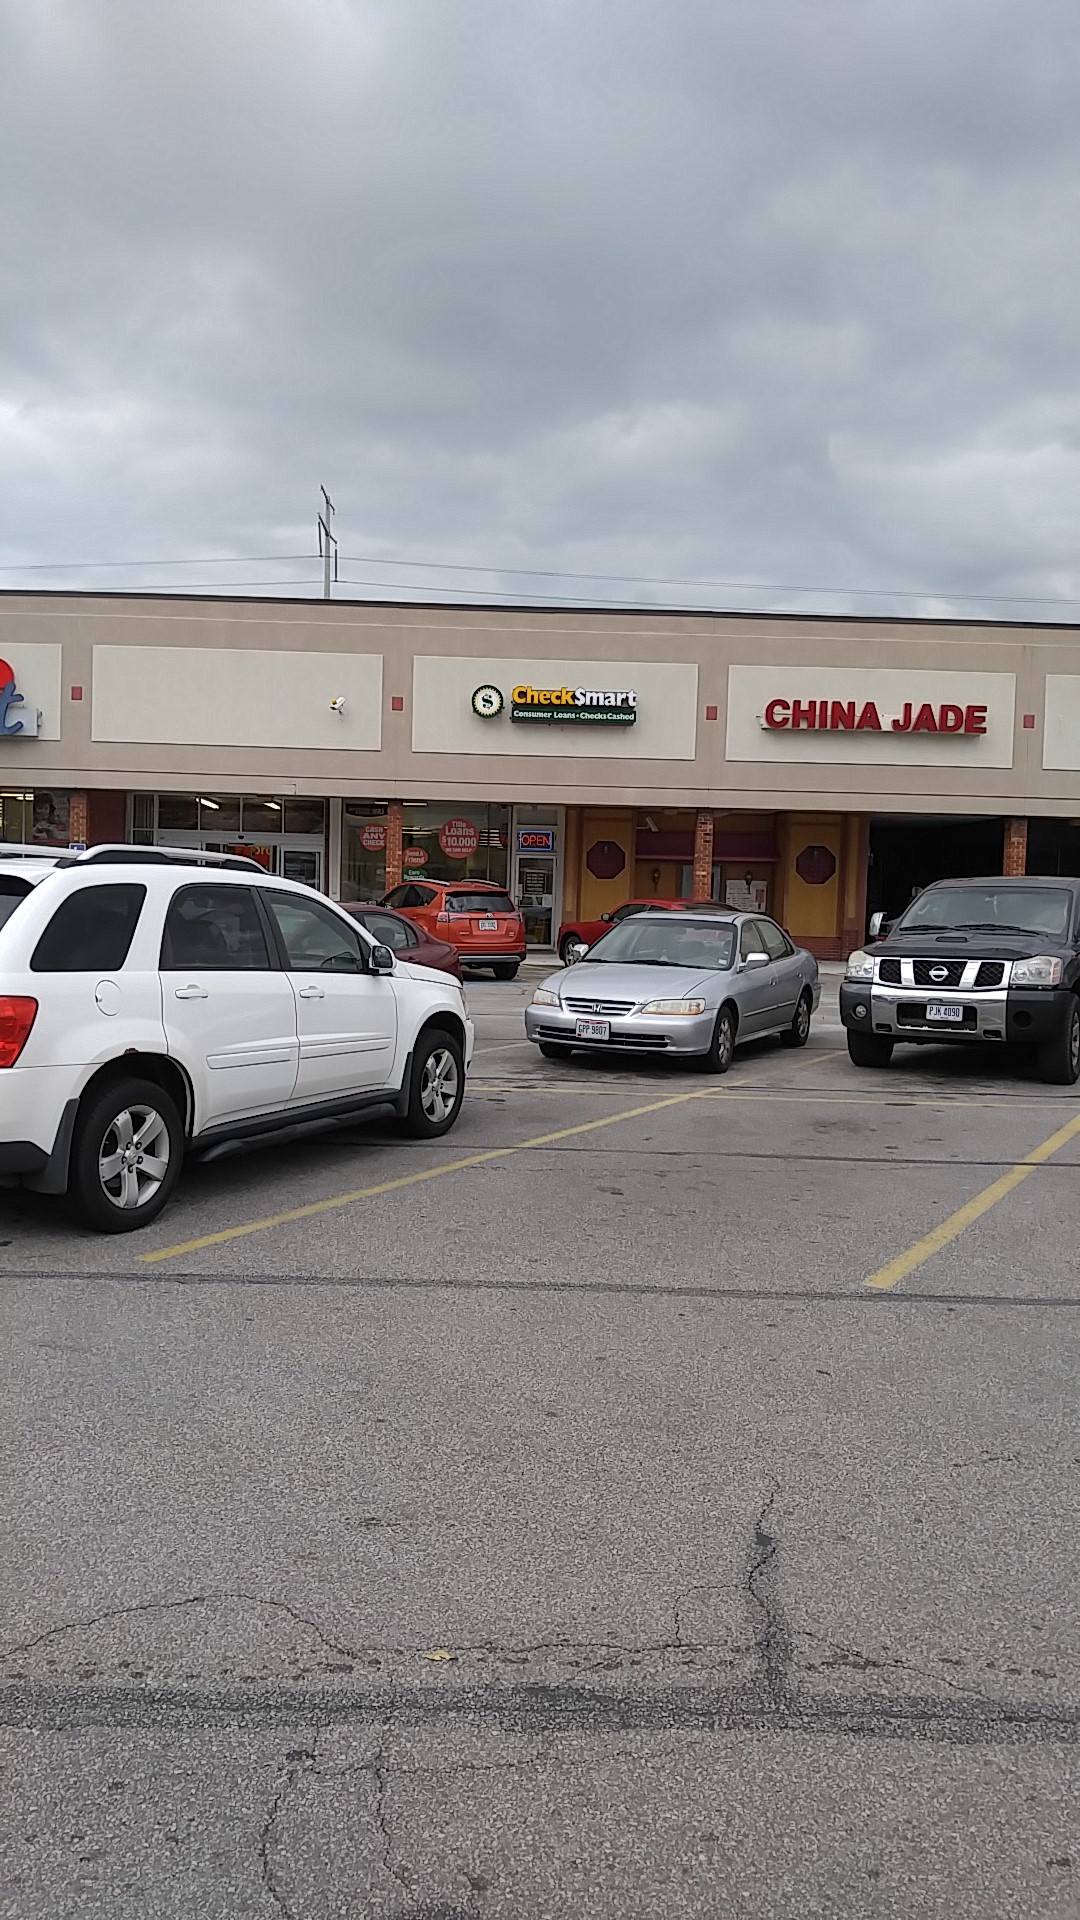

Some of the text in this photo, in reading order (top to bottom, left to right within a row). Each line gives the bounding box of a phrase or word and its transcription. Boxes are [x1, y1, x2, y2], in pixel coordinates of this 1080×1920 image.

[513, 710, 552, 718] Consumer
[553, 711, 576, 719] Loans
[765, 699, 988, 734] CHINA JADE
[445, 826, 475, 836] Loans
[521, 835, 551, 846] OPEN
[929, 1006, 960, 1017] PJK 4090
